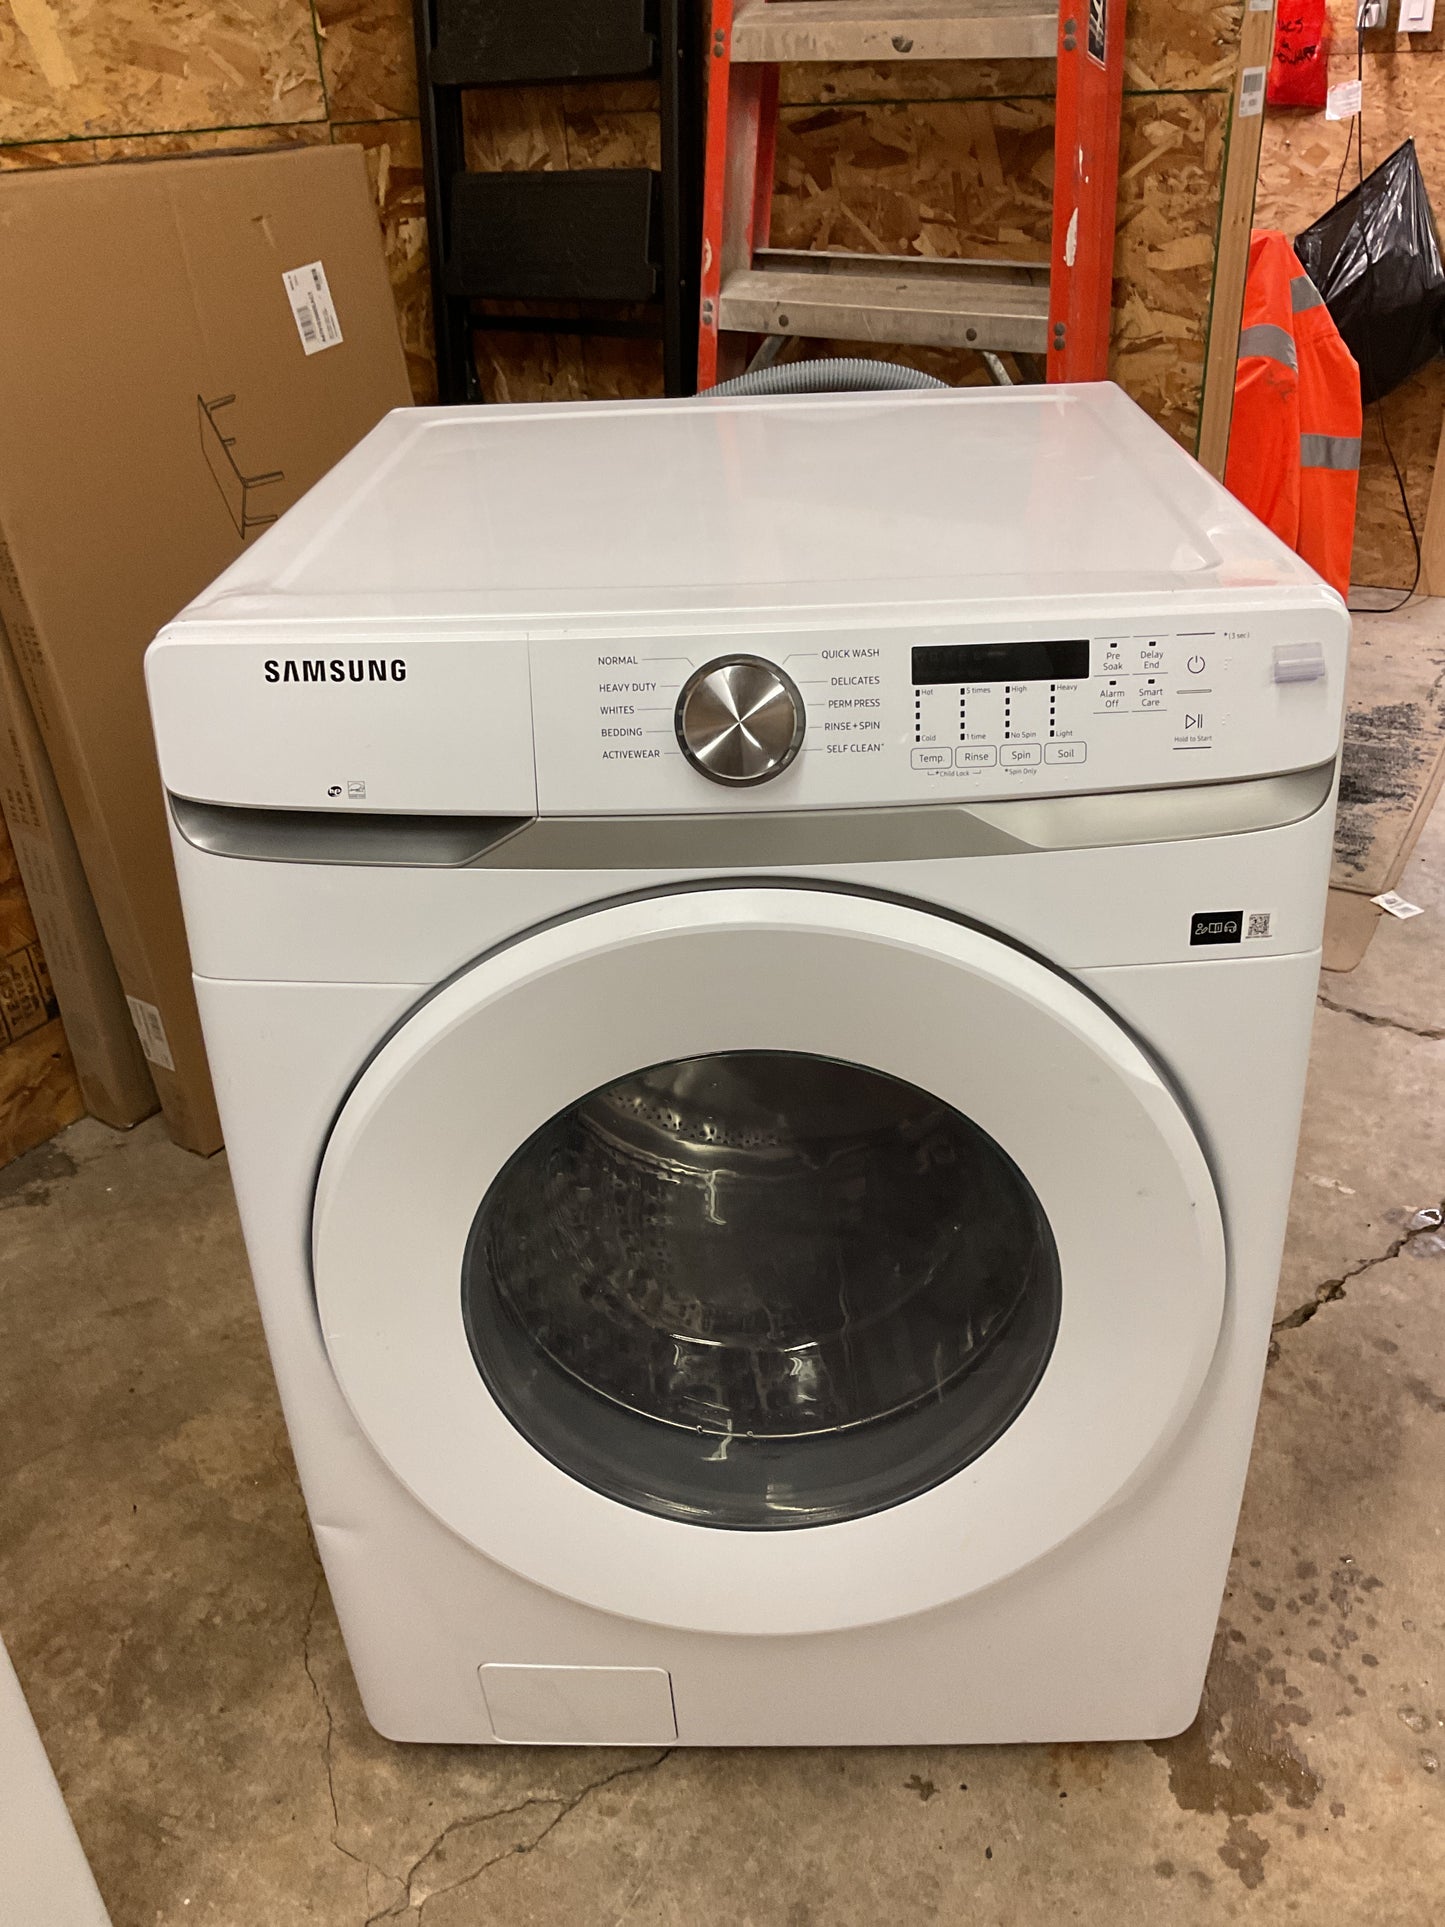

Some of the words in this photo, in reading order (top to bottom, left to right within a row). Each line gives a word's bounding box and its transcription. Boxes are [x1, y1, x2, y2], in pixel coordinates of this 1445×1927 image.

[821, 649, 850, 659] QUICK
[852, 648, 880, 658] WASH
[1106, 652, 1121, 660] Pre
[1140, 650, 1164, 660] Delay
[598, 656, 638, 665] NORMAL
[1143, 660, 1160, 669] End
[264, 659, 406, 683] SAMSUNG
[1103, 662, 1123, 671] Soak
[831, 676, 880, 686] DELICATES
[599, 683, 630, 692] HEAVY
[632, 682, 656, 692] DUTY
[972, 686, 991, 695] times
[1011, 685, 1027, 694] High
[1056, 684, 1078, 692] Heavy
[921, 688, 934, 696] Hot
[1099, 690, 1125, 698] Alarm
[1138, 688, 1163, 697] Smart
[828, 700, 852, 709] PERM
[853, 699, 880, 708] PRESS
[1105, 699, 1119, 708] Off
[1141, 698, 1160, 707] Care
[600, 706, 635, 715] WHITES
[601, 728, 643, 737] BEDDING
[971, 732, 987, 740] time
[1022, 731, 1037, 740] Spin
[1055, 730, 1073, 738] Light
[921, 734, 937, 742] Cold
[827, 744, 848, 753] SELF
[602, 750, 661, 759] ACTIVEWEAR
[964, 753, 989, 761] Rinse
[1011, 751, 1031, 760] Spin
[1057, 749, 1075, 758] Soil
